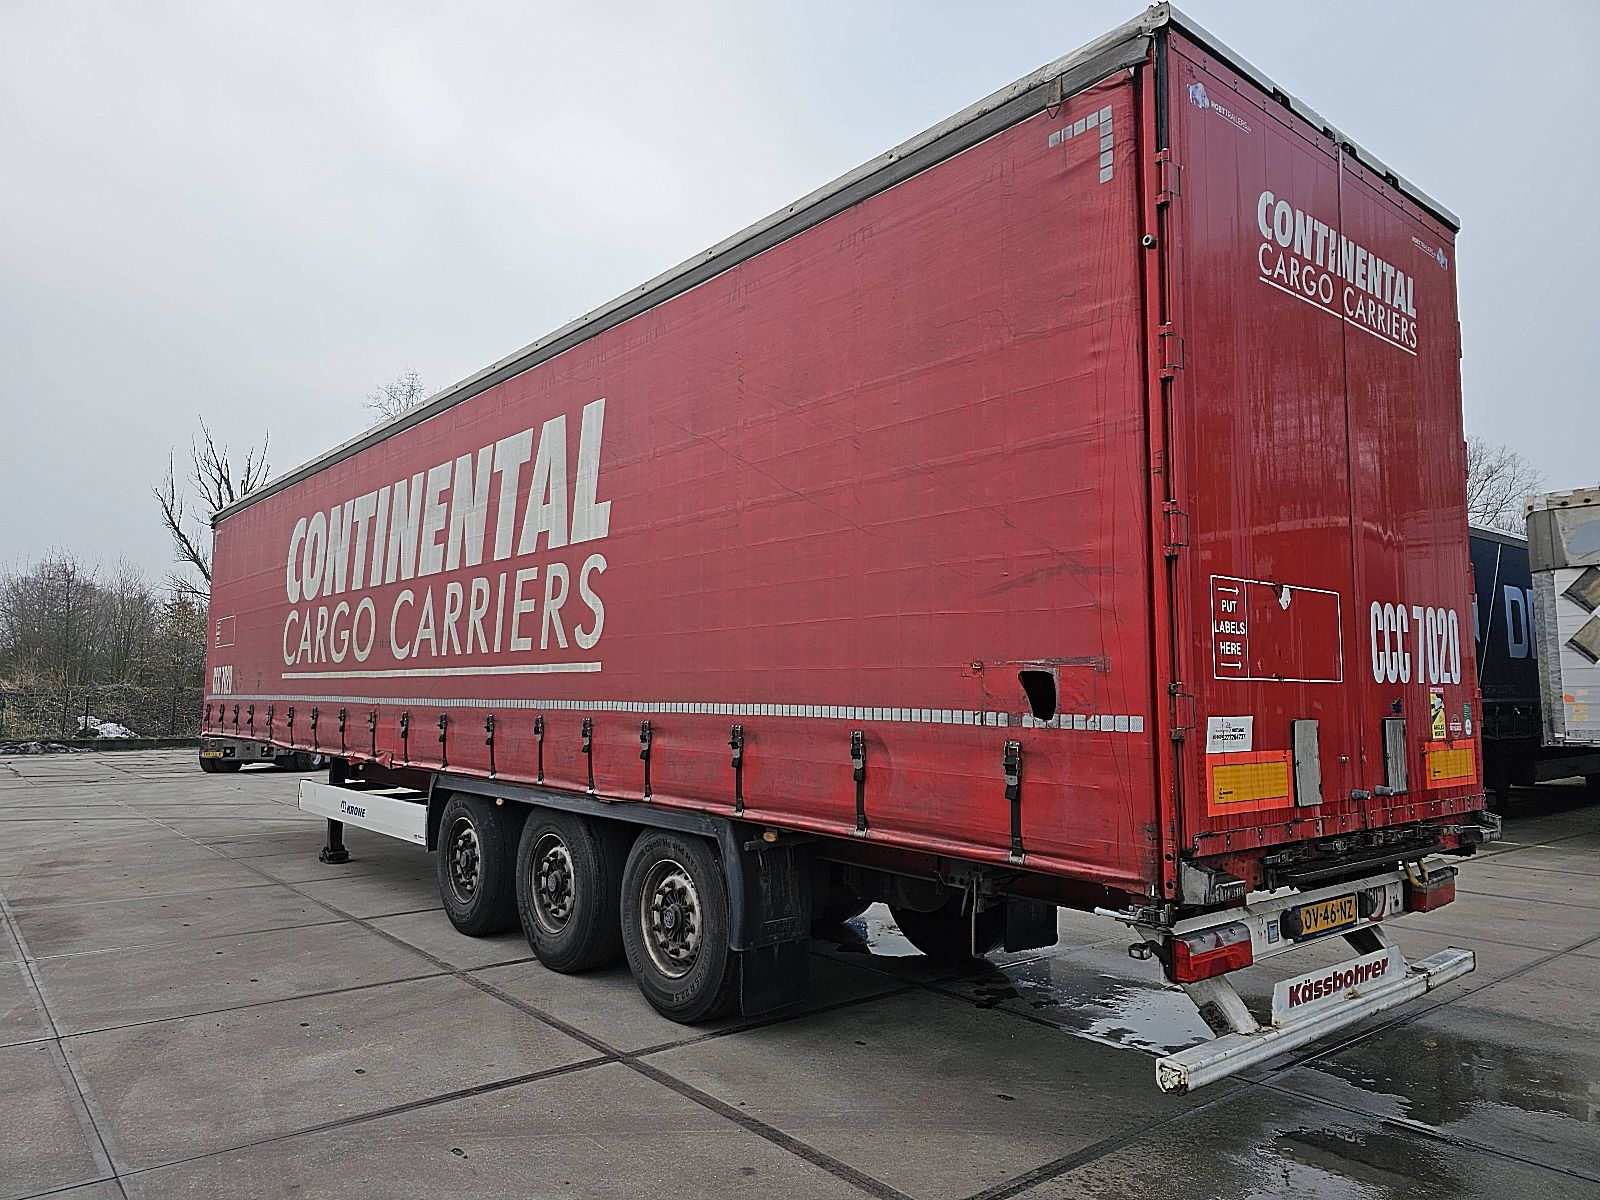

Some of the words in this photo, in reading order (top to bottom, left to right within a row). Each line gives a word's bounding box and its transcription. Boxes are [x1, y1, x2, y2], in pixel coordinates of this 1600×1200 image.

[1257, 190, 1417, 319] CONTINENTAL
[1258, 243, 1333, 304] CARGO
[1343, 286, 1417, 349] CARRIERS
[286, 398, 612, 604] CONTINENTAL
[282, 596, 376, 666] CARGO
[390, 553, 608, 661] CARRIERS
[1214, 620, 1246, 635] LABELS
[1221, 600, 1237, 613] PUT
[1219, 641, 1242, 656] HERE
[1370, 600, 1411, 684] CCC
[1412, 605, 1461, 685] 7020
[346, 804, 366, 818] KRONE
[1304, 899, 1355, 930] OV-46-NZ
[1288, 957, 1389, 1009] Kässbohrer
